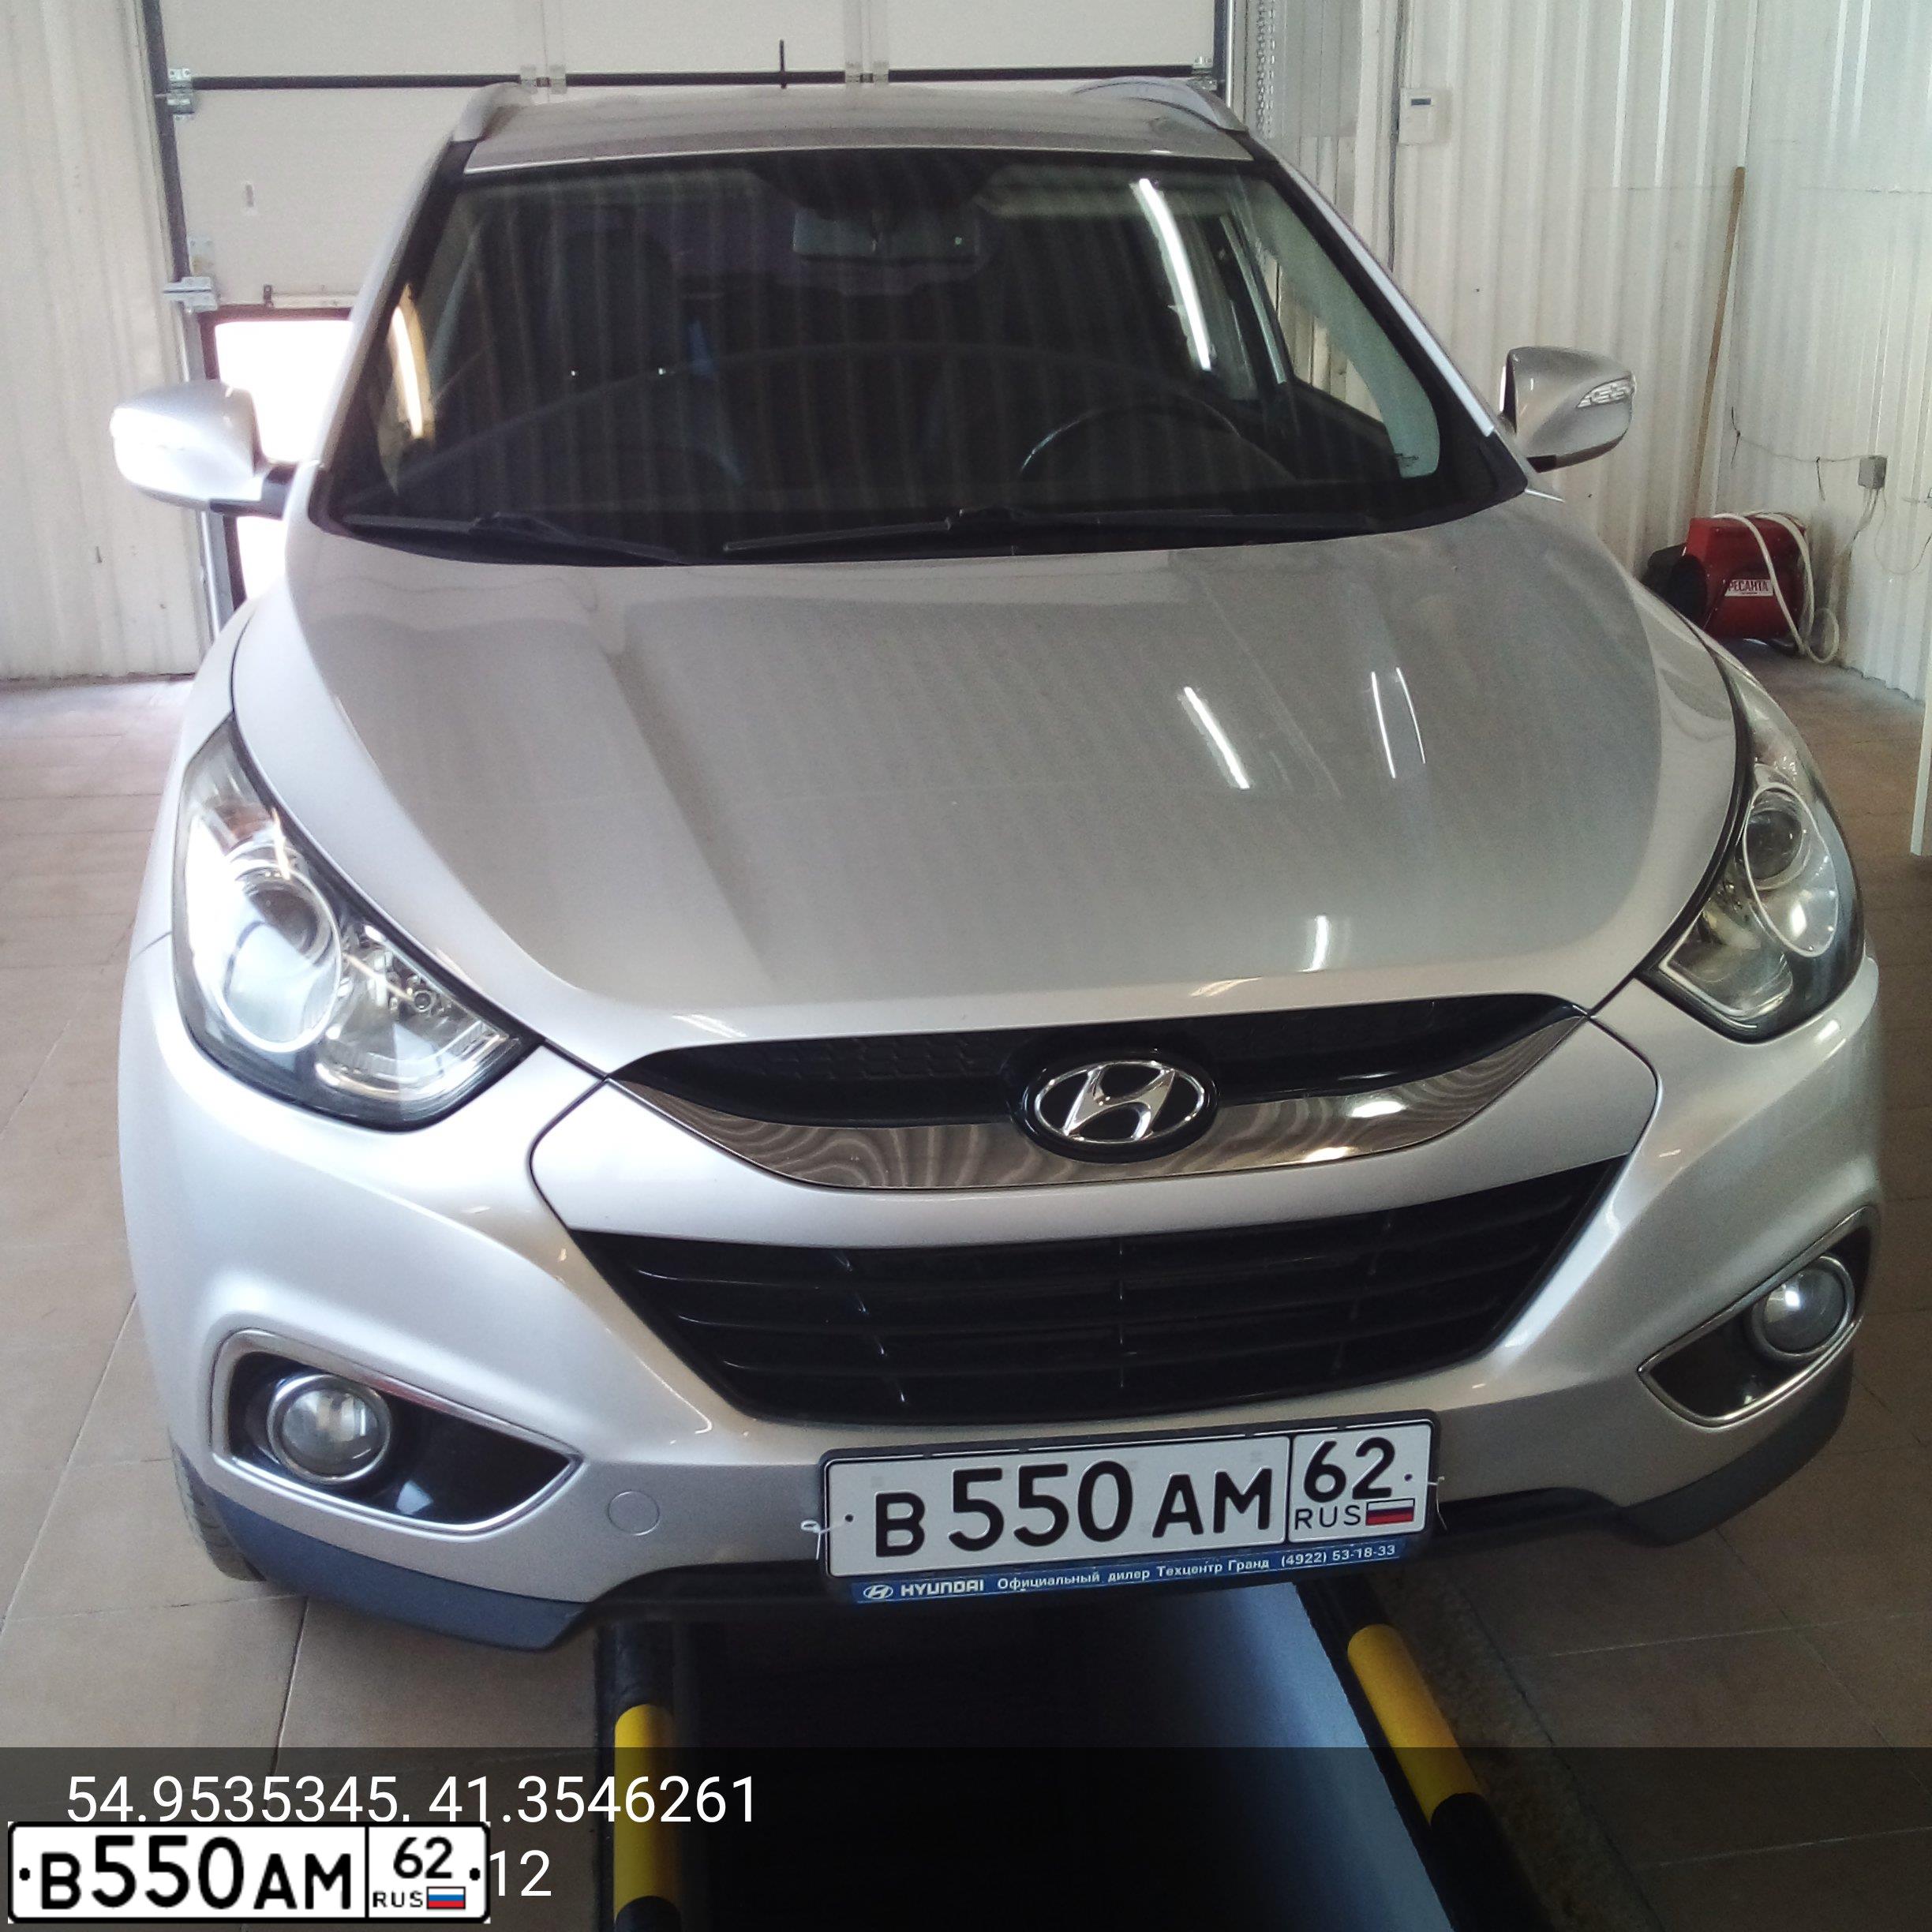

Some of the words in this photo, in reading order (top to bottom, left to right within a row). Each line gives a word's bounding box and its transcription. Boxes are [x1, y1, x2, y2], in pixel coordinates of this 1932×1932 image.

[1304, 1436, 1395, 1503] 62
[1294, 1505, 1361, 1530] RUS
[900, 1579, 984, 1597] HYUNDAI
[997, 1571, 1101, 1593] Официальный
[1108, 1569, 1151, 1583] дилер
[1156, 1563, 1222, 1576] Техцентр
[1228, 1559, 1270, 1572] Гранд
[1281, 1552, 1327, 1567] (4922)
[1332, 1544, 1396, 1561] 53-18-33
